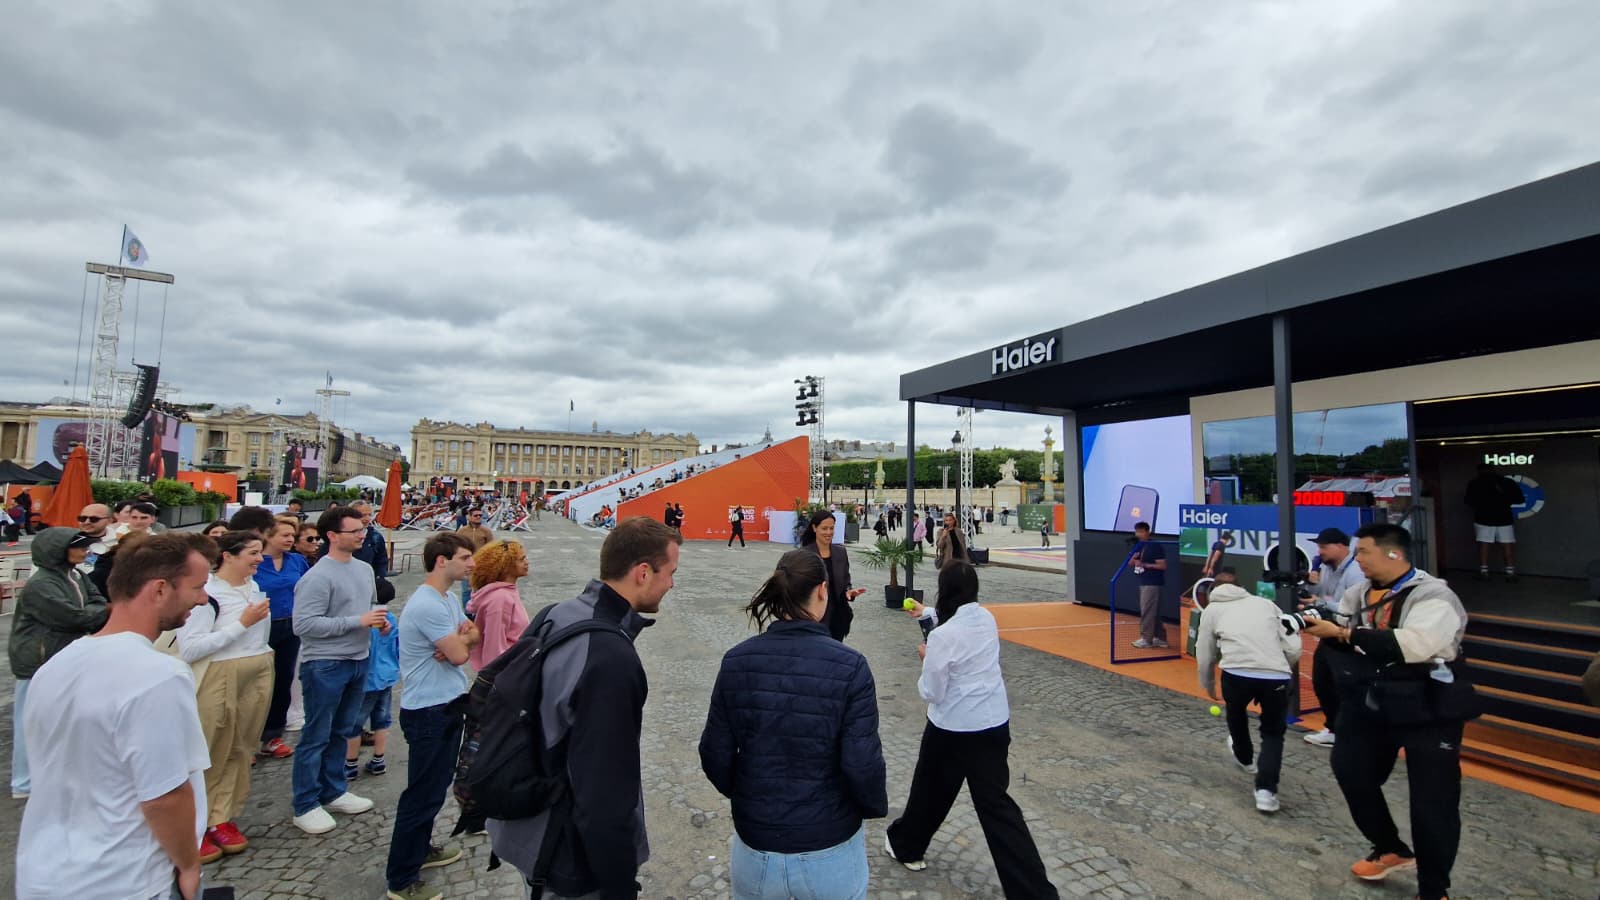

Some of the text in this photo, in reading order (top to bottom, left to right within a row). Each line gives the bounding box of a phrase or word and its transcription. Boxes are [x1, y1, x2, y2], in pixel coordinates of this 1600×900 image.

[992, 337, 1055, 375] Haier
[1484, 452, 1534, 465] Haier
[1183, 509, 1228, 525] Haier
